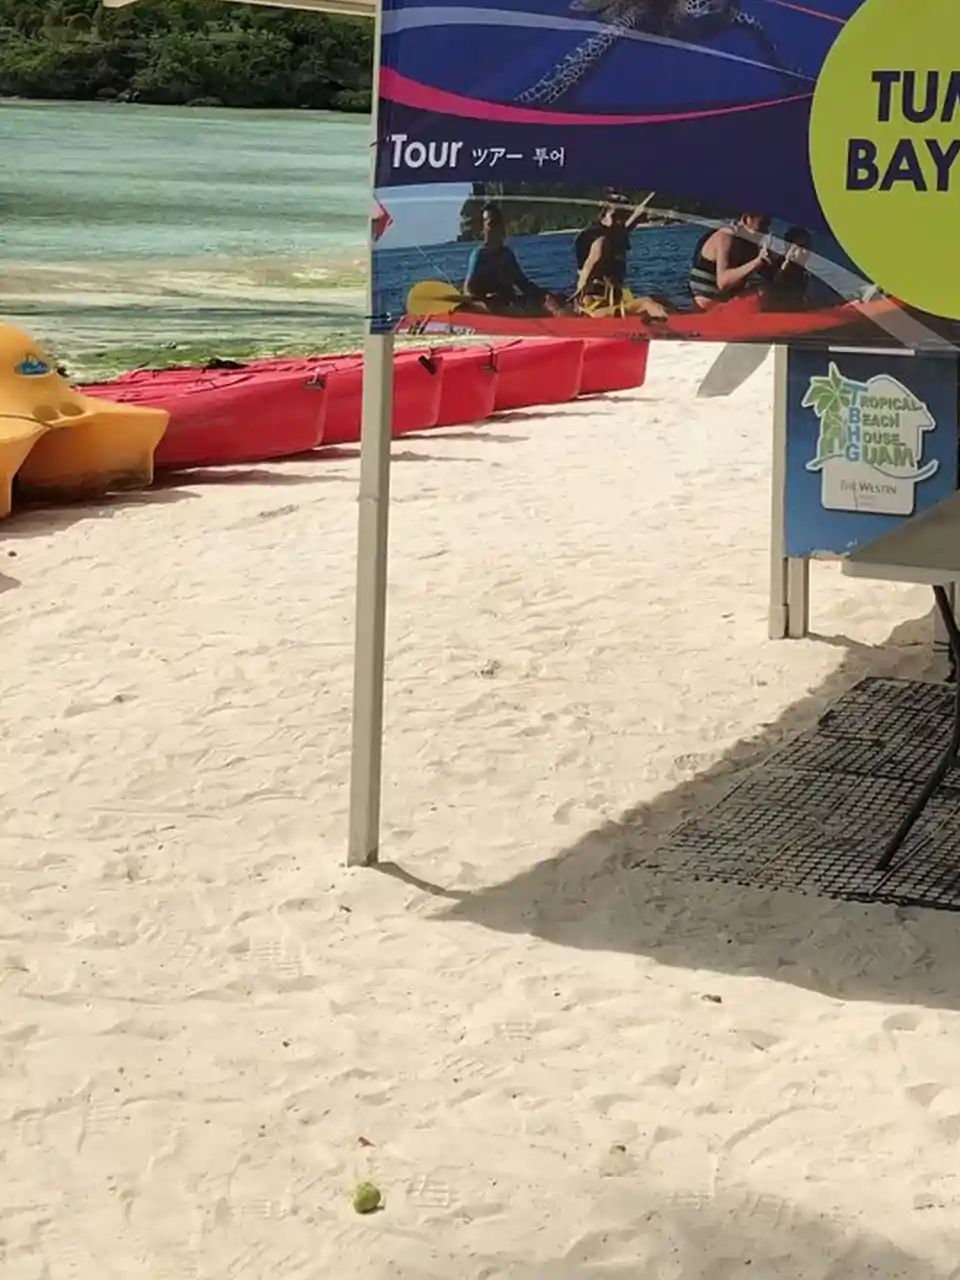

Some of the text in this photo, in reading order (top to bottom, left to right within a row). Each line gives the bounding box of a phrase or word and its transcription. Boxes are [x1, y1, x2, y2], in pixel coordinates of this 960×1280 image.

[390, 133, 463, 169] Tour
[472, 147, 524, 167] ツアー
[845, 445, 916, 468] GUAM
